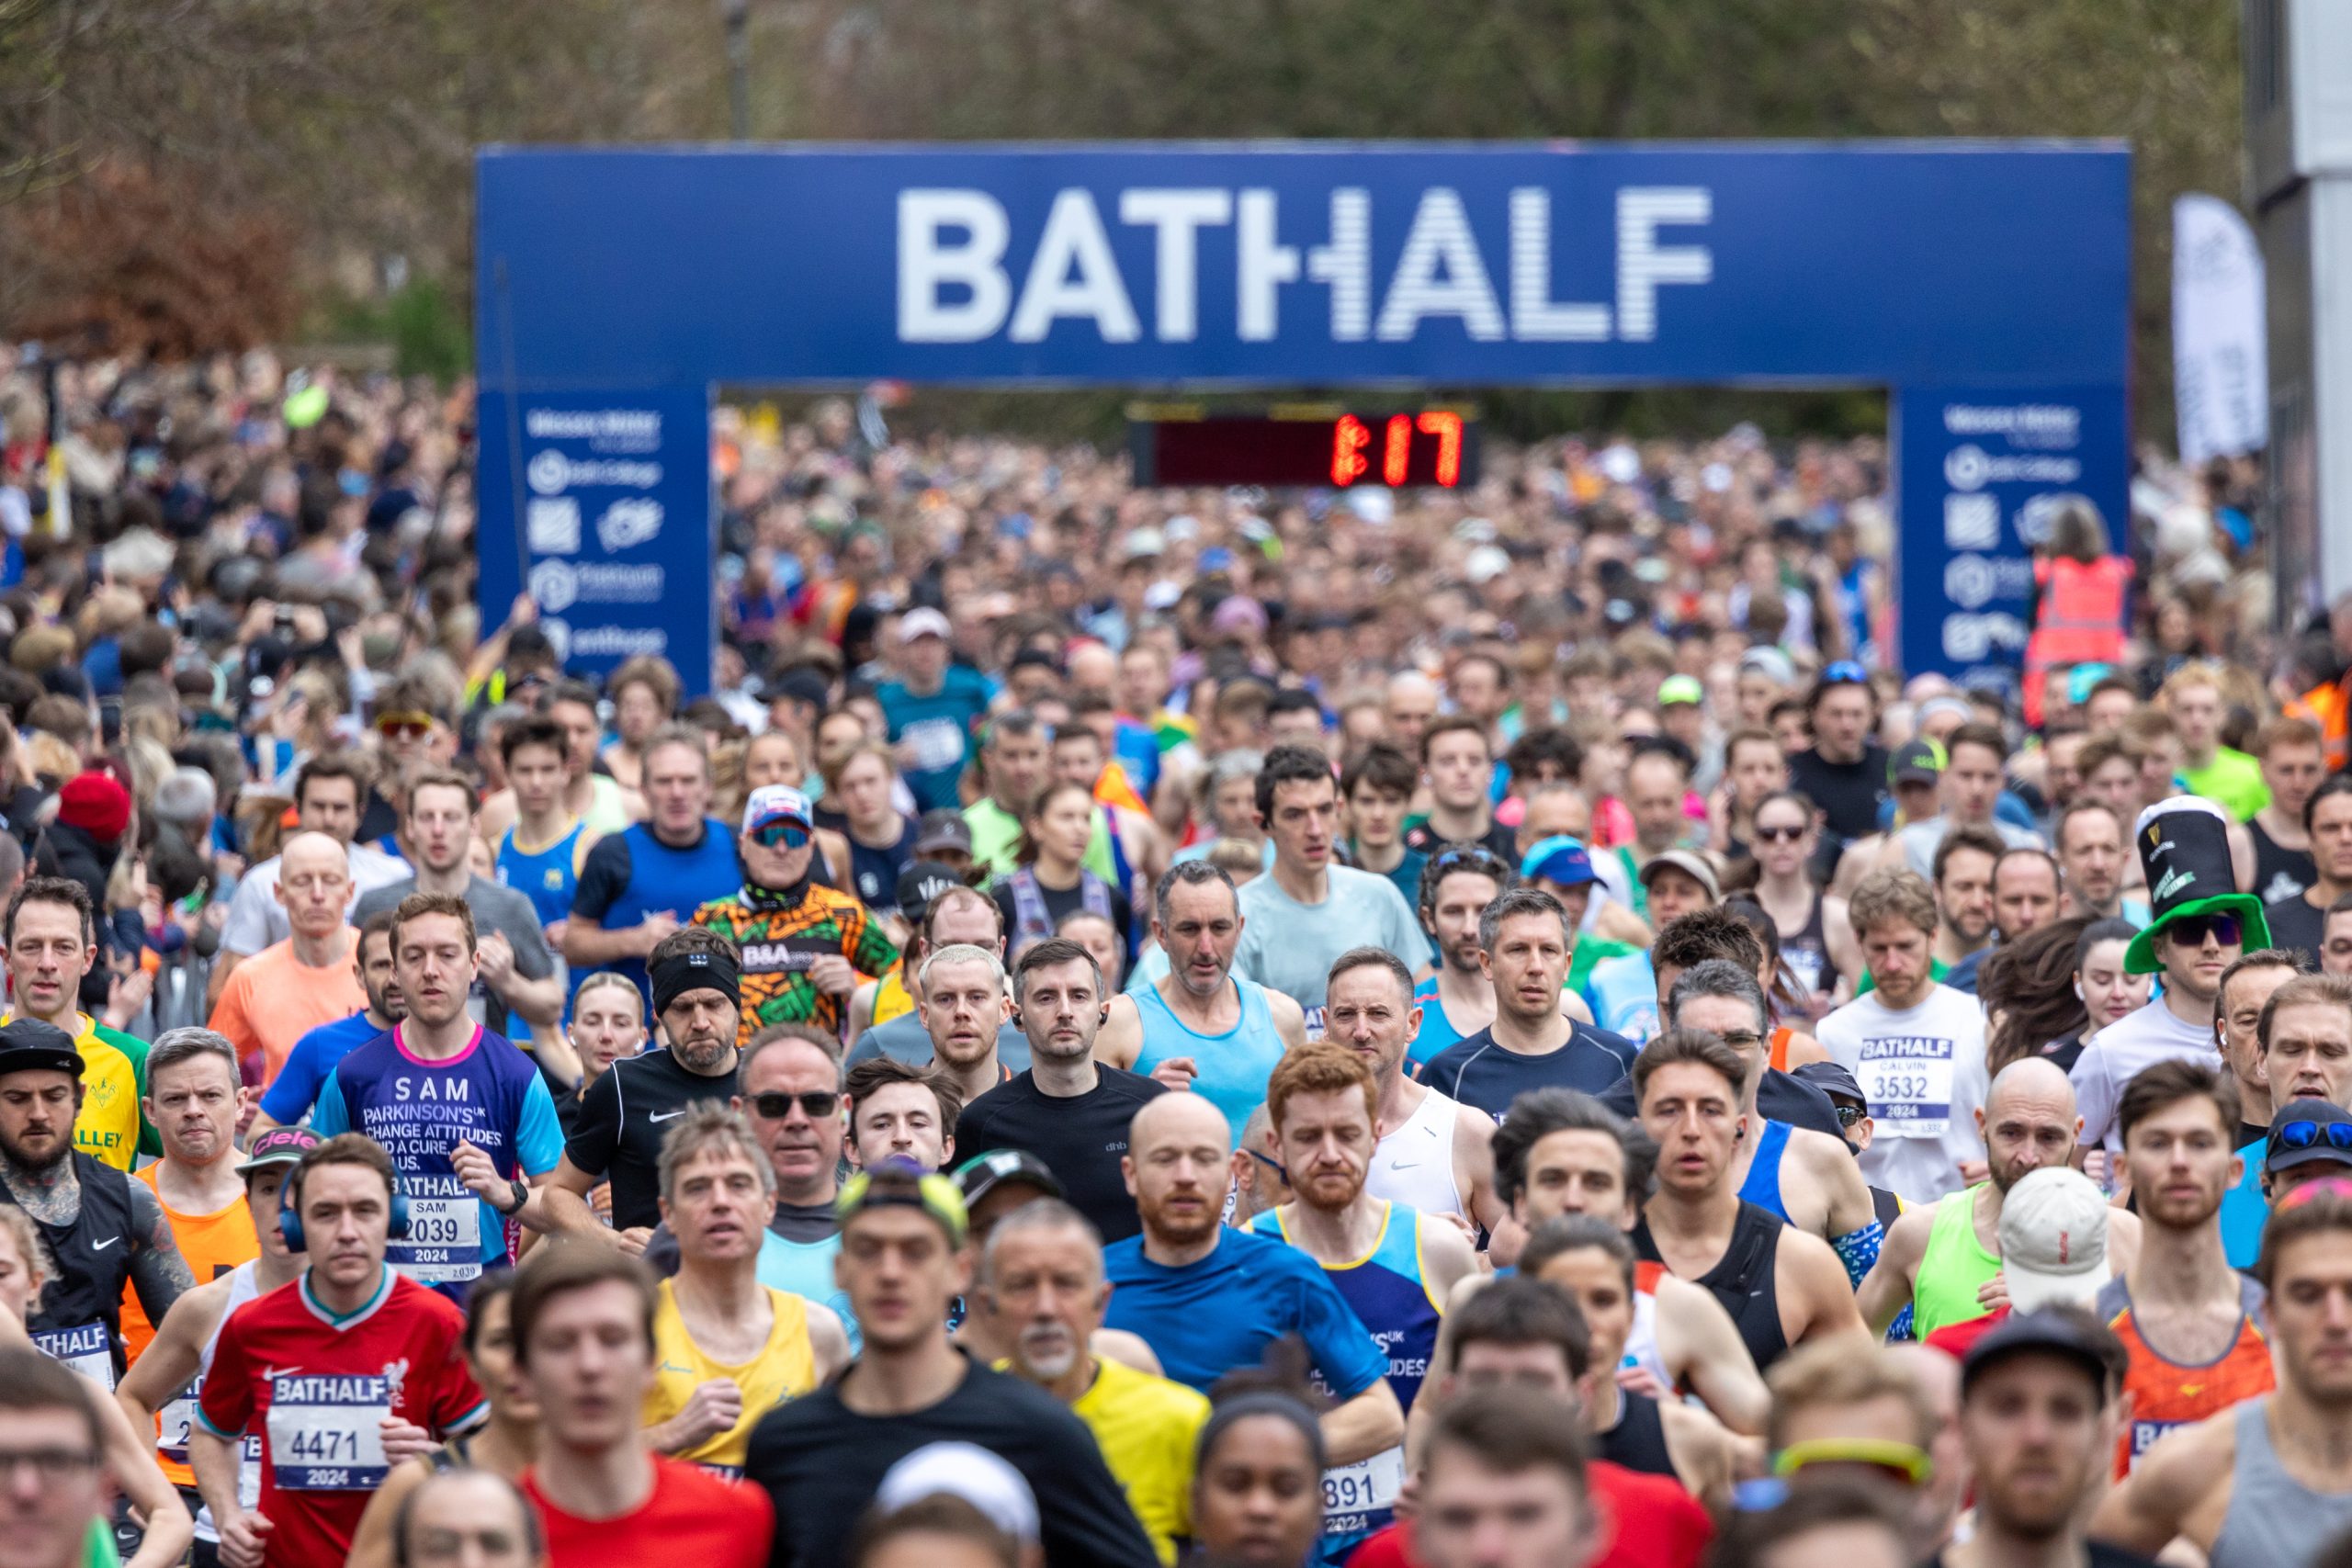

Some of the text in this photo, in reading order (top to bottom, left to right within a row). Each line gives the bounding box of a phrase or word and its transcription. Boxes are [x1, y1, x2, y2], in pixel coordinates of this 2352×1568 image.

[898, 186, 1713, 343] BATHALF
[741, 943, 791, 966] B&A
[1862, 1038, 1949, 1059] BATHALF
[1880, 1061, 1927, 1071] CALVIN
[1874, 1077, 1928, 1098] 3532
[1886, 1104, 1919, 1118] 2024
[366, 1122, 421, 1140] CHANGE
[1105, 1142, 1126, 1152] dhb
[416, 1202, 447, 1213] SAM
[402, 1219, 458, 1242] 2039
[415, 1249, 448, 1262] 2024
[29, 1326, 106, 1355] THALF
[277, 1378, 385, 1402] BATHALF
[291, 1429, 357, 1461] 4471
[307, 1470, 349, 1486] 2024
[1326, 1514, 1368, 1533] 2024
